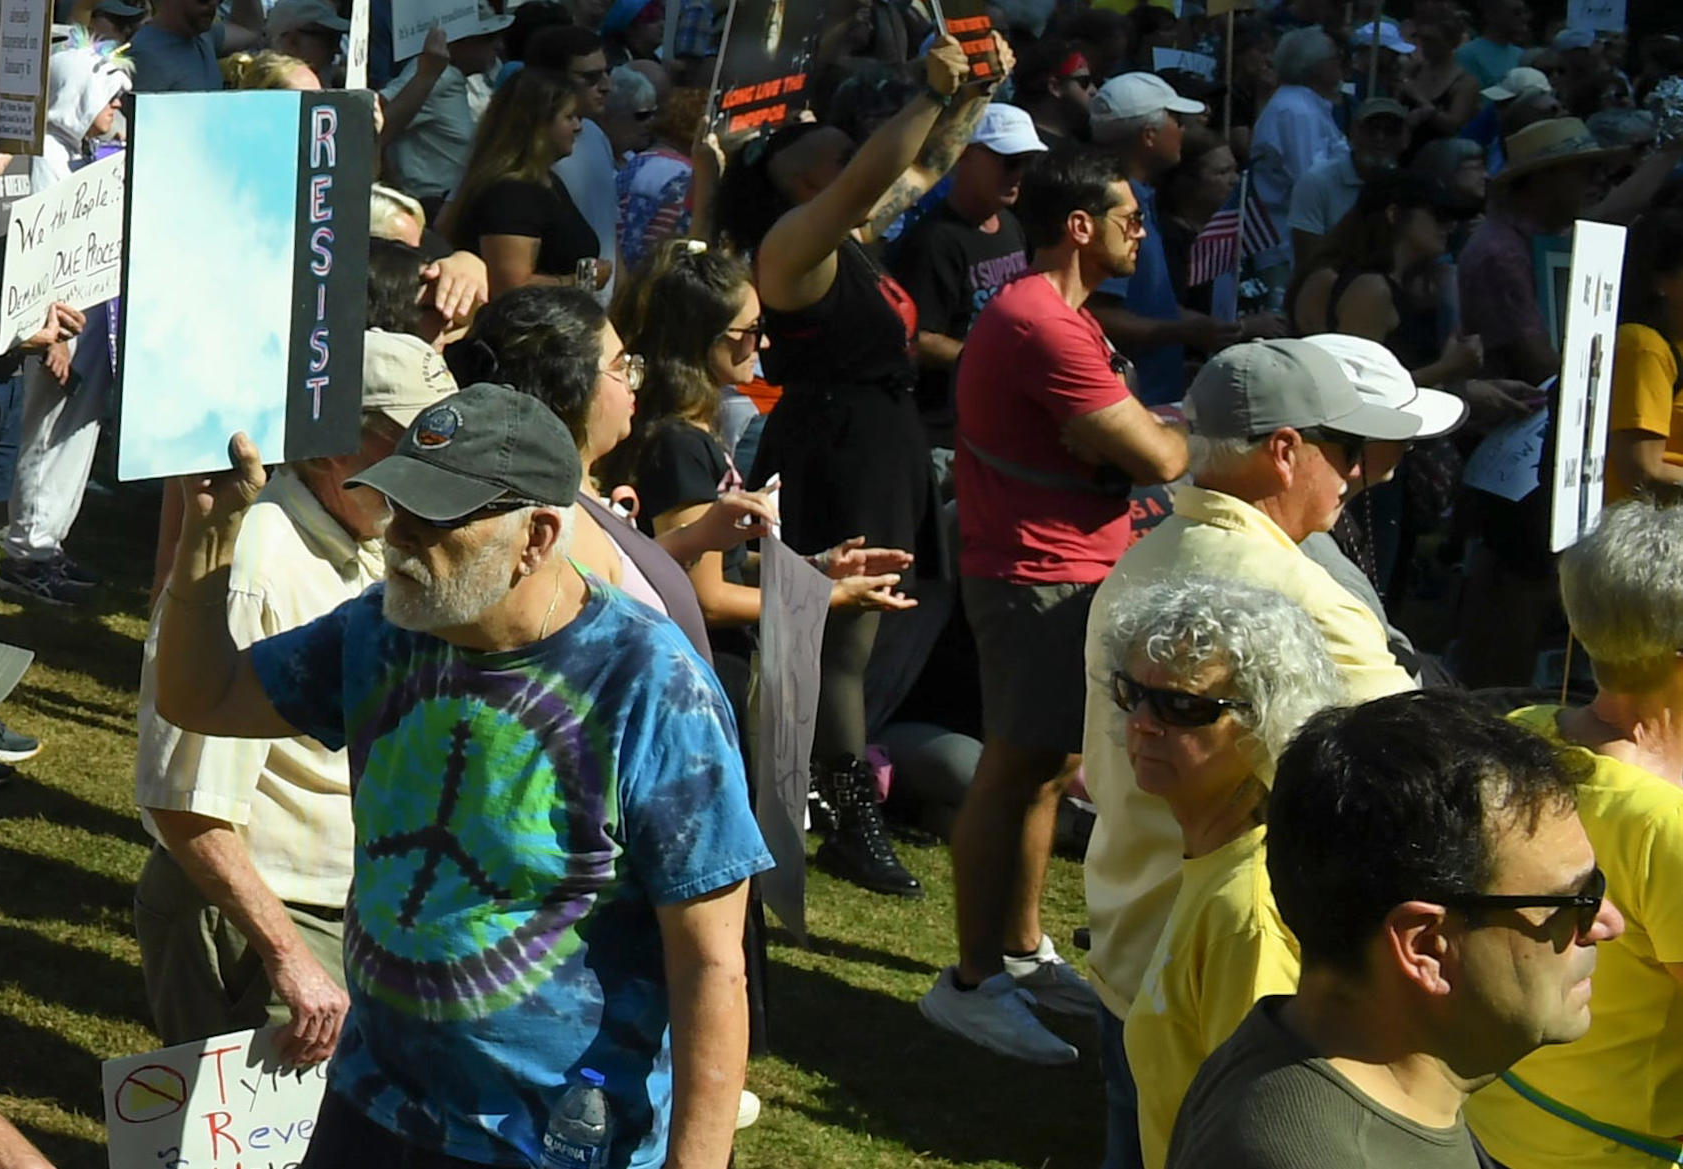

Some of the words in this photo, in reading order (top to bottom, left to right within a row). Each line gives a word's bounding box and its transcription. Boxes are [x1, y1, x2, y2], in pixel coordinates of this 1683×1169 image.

[14, 203, 45, 254] We
[50, 200, 67, 231] the
[7, 273, 50, 316] DEMAND
[52, 244, 83, 285] DUE
[306, 104, 339, 420] RESIST
[200, 1110, 314, 1161] Reve
